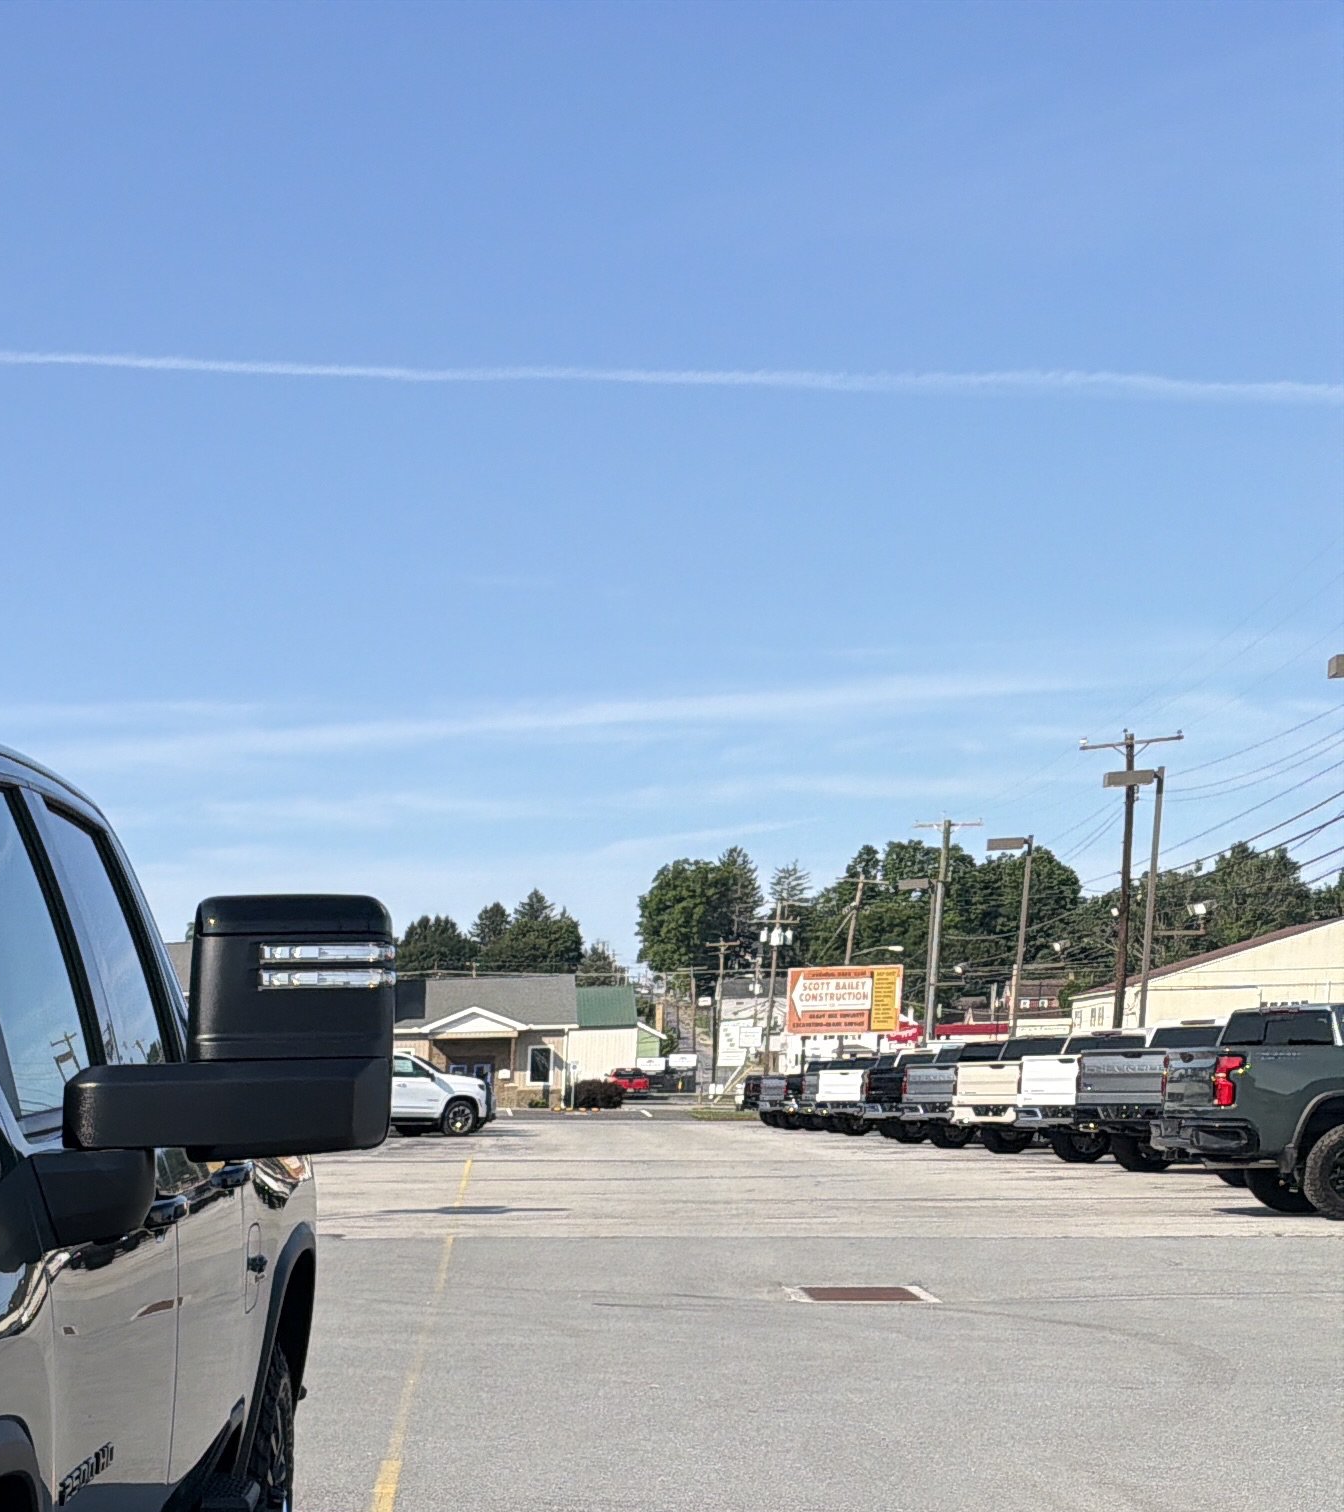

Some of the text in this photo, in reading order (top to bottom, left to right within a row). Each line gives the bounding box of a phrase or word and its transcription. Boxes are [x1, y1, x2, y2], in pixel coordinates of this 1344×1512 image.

[802, 980, 867, 991] SCOTT BAILEY
[799, 991, 869, 1002] CONSTRUCTION
